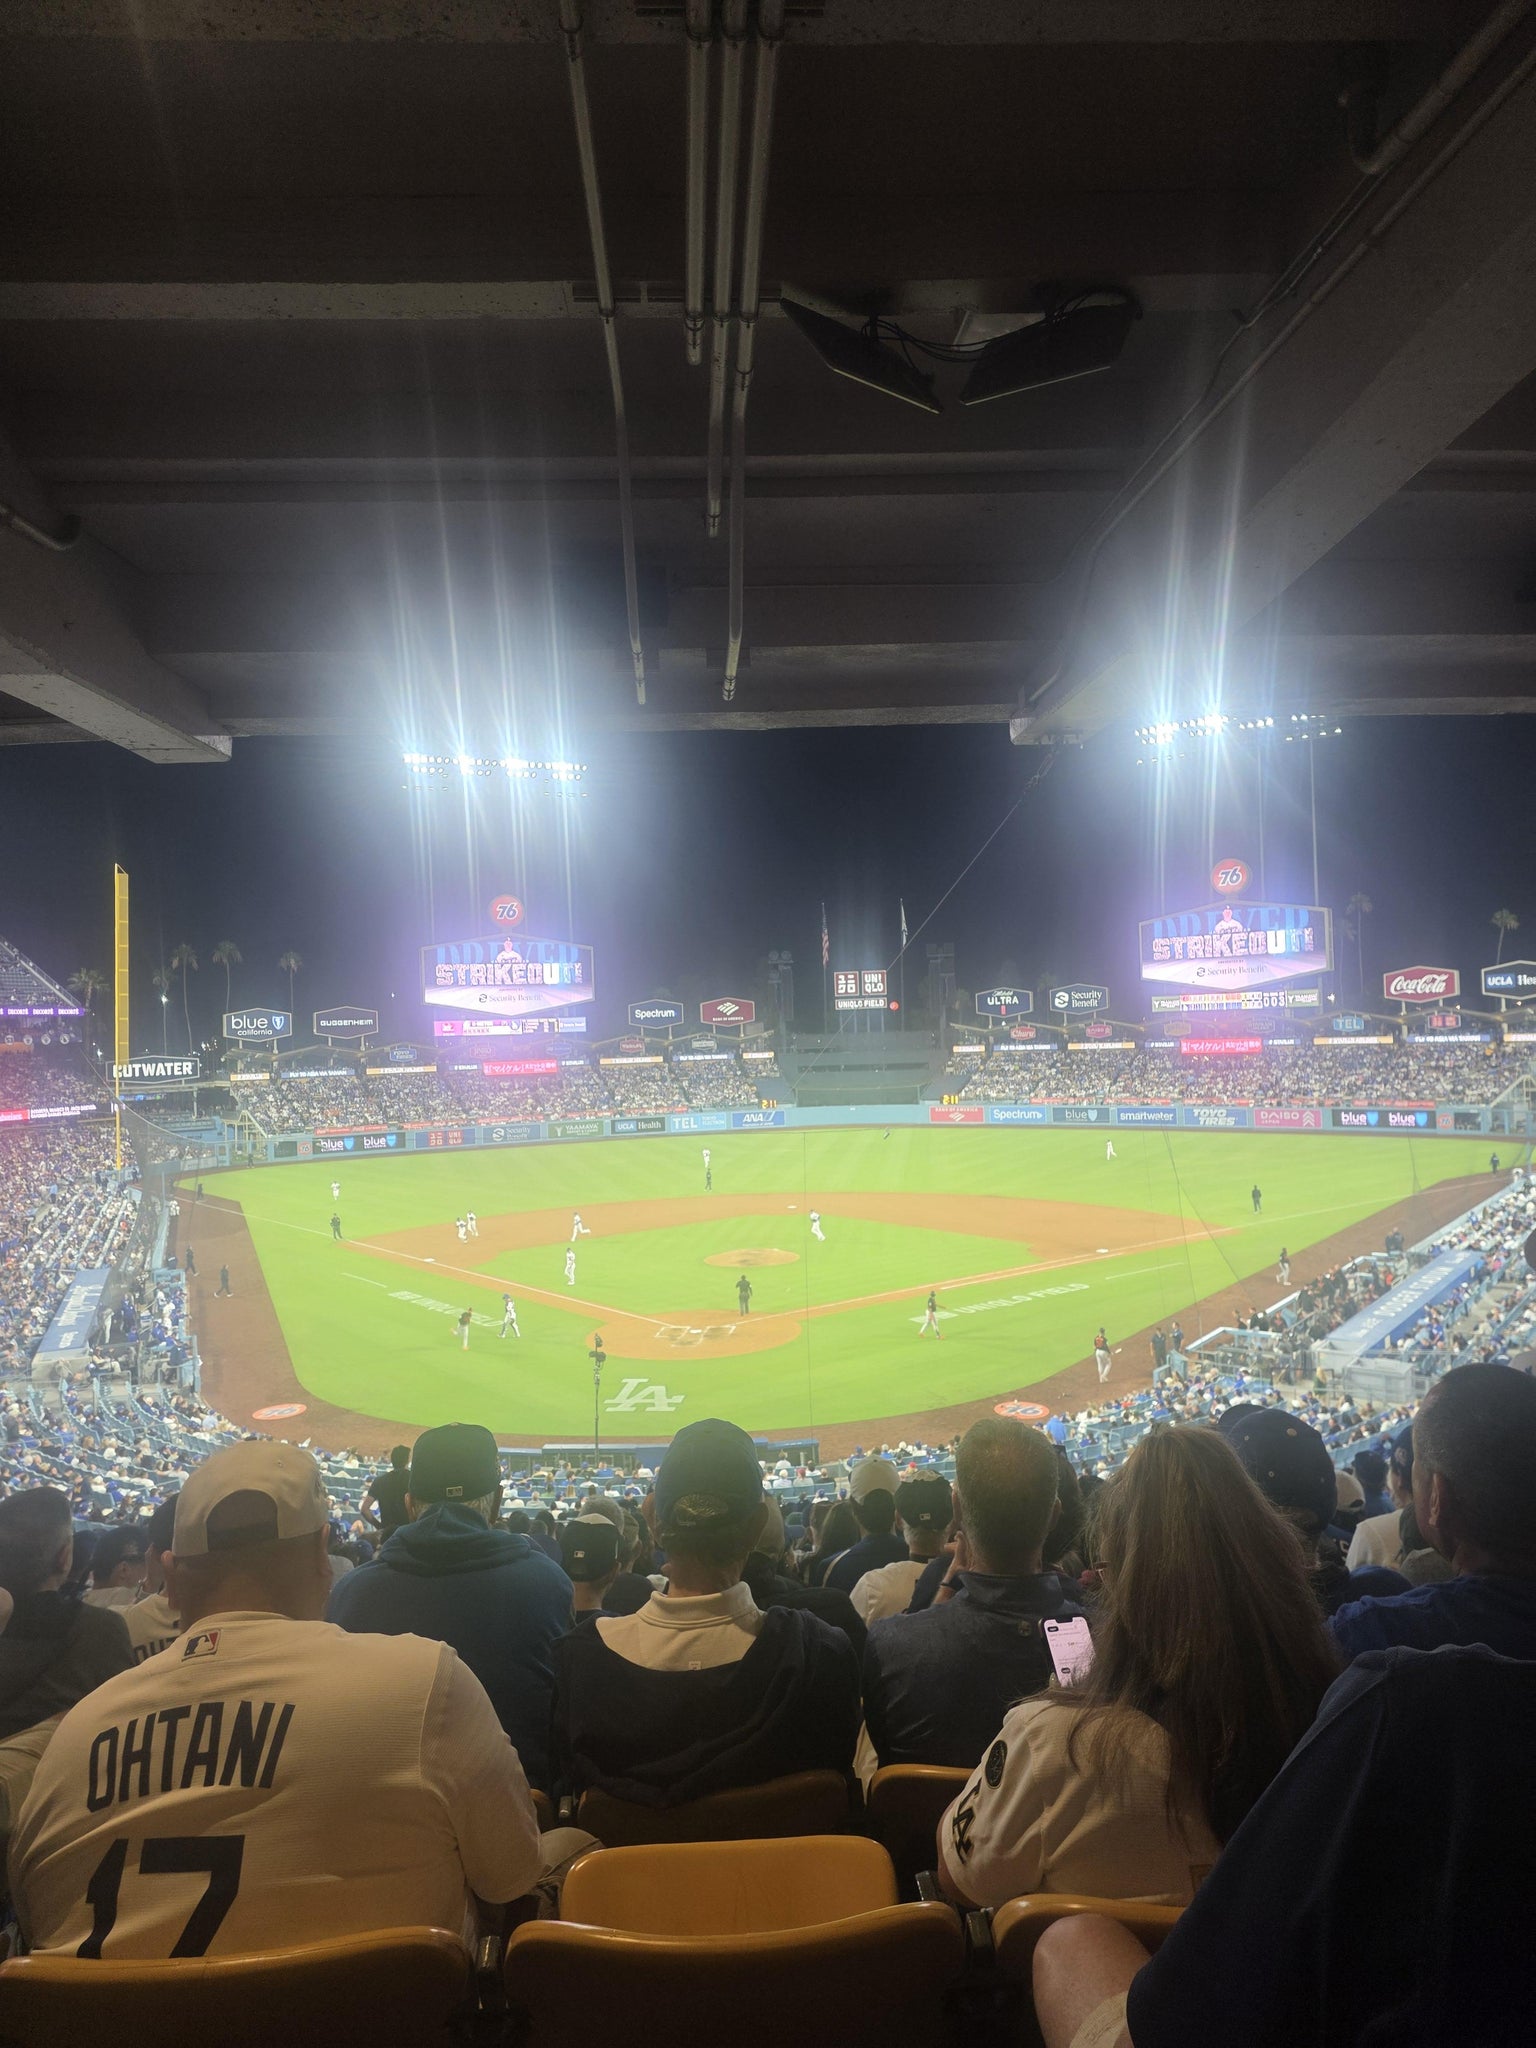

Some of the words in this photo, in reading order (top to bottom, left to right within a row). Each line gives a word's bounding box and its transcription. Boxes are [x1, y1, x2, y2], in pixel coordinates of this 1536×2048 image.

[1218, 866, 1242, 886] 76
[496, 902, 519, 920] 76
[1207, 967, 1237, 976] Security
[1238, 965, 1266, 974] Benefit
[1487, 976, 1513, 986] UCLA
[987, 996, 1019, 1005] ULTRA
[1071, 991, 1102, 1000] Security
[838, 1000, 863, 1009] UNIQLO
[863, 999, 885, 1008] FIELD
[1072, 999, 1098, 1008] Benefit
[635, 1009, 675, 1020] Spectrum
[231, 1014, 269, 1029] blue
[320, 1019, 373, 1027] GUGGENHEIM
[1336, 1018, 1361, 1029] TEL
[112, 1062, 193, 1078] CUTWATER
[743, 1113, 763, 1122] ANA
[993, 1109, 1039, 1120] Spectrum
[1065, 1109, 1088, 1119] blue
[1120, 1111, 1174, 1121] smartwater
[1193, 1109, 1227, 1117] TOYO
[1341, 1111, 1367, 1122] blue
[1389, 1112, 1416, 1123] blue
[618, 1122, 634, 1130] UCLA
[638, 1121, 662, 1130] Health
[672, 1117, 698, 1130] TEL
[1199, 1117, 1236, 1126] TIRES
[505, 1126, 531, 1134] Security
[320, 1139, 343, 1149] blue
[363, 1136, 386, 1147] blue
[953, 1294, 1033, 1315] UNIQLO
[1028, 1282, 1091, 1300] FIELD
[604, 1378, 686, 1412] LA
[86, 1701, 296, 1812] OHTANI
[76, 1834, 246, 1959] 17
